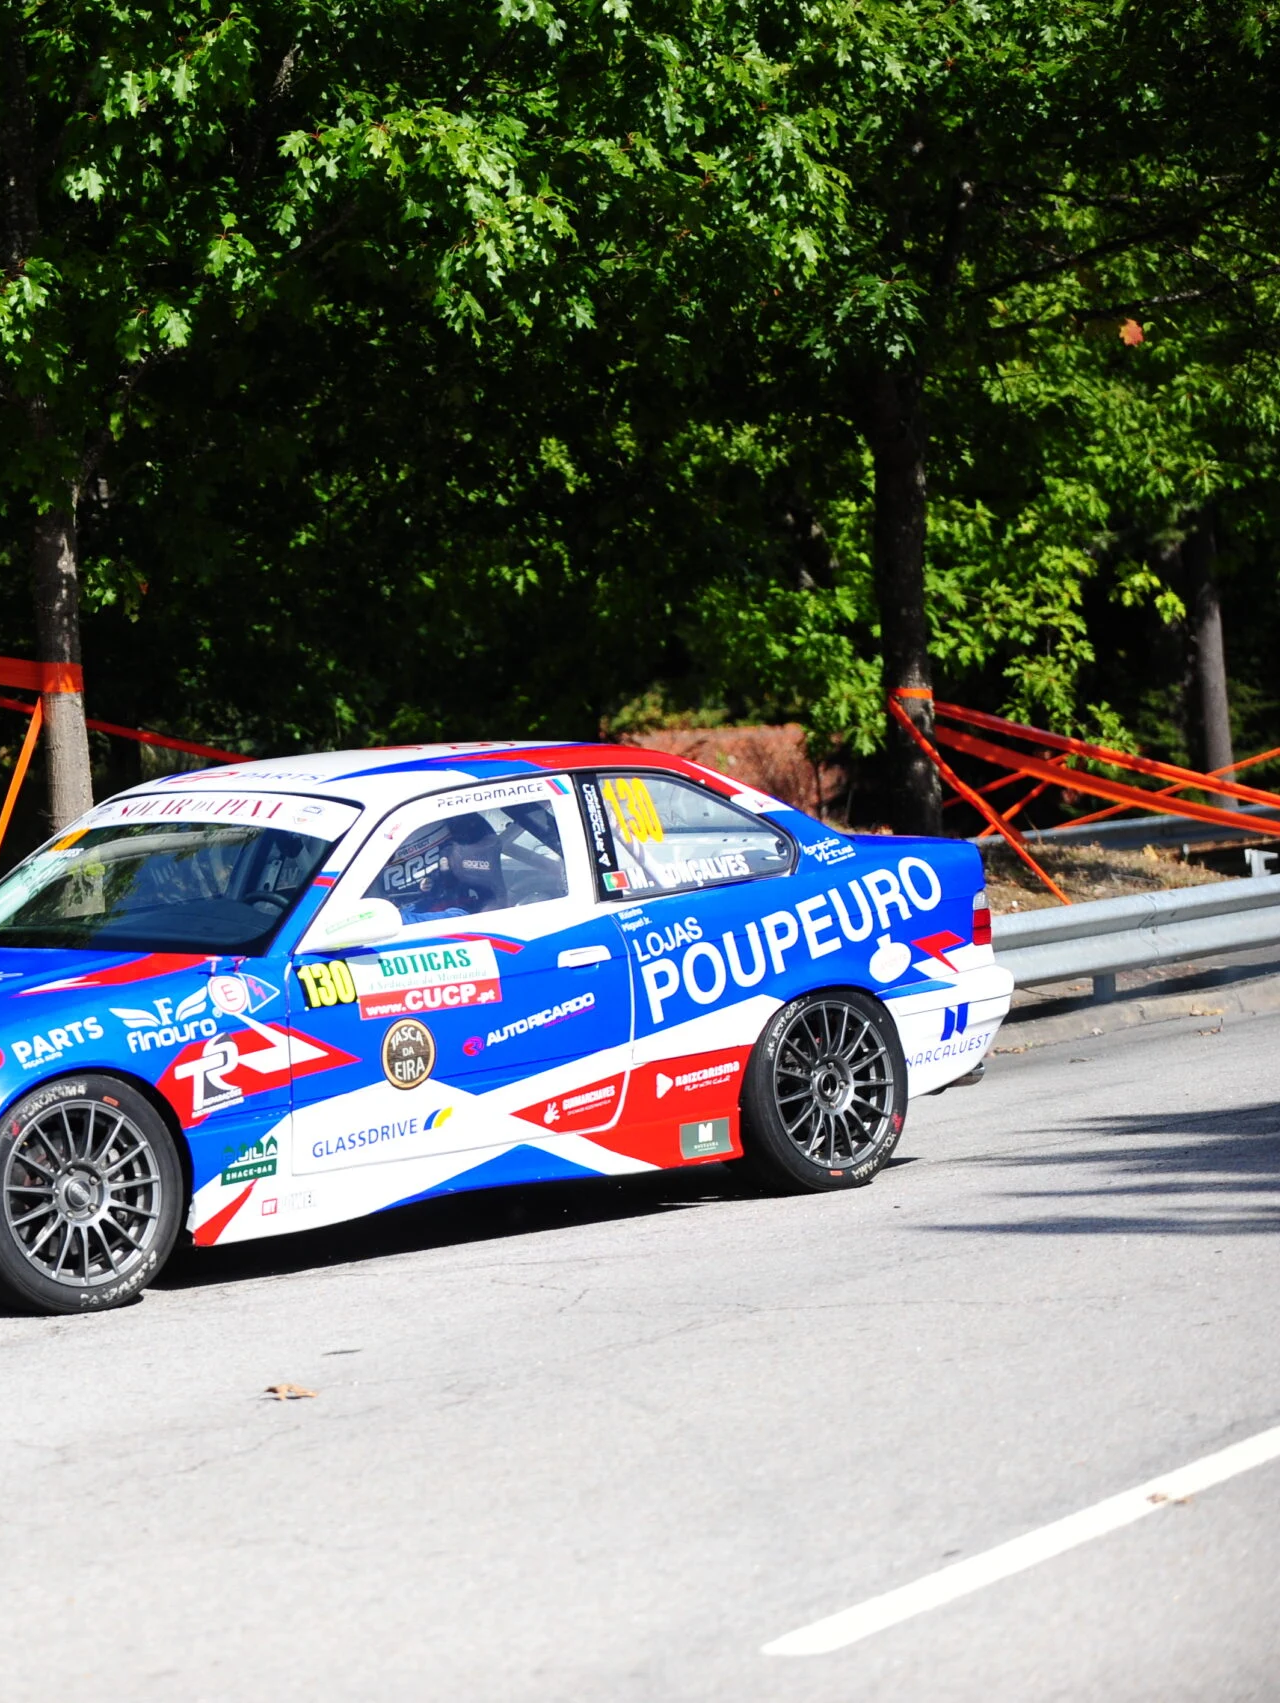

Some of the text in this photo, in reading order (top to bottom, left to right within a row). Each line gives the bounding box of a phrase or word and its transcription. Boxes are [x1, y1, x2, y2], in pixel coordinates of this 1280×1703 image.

[437, 783, 544, 808] PERFORMANCE
[602, 777, 664, 844] 130
[803, 837, 840, 856] Ignição
[814, 845, 854, 862] Virtual
[626, 853, 751, 890] M. GONÇALVES
[632, 917, 703, 962] LOJAS
[640, 856, 942, 1025] POUPEURO
[379, 949, 472, 977] BOTICAS
[297, 960, 357, 1009] 130
[11, 1016, 104, 1064] PARTS
[390, 1026, 424, 1051] TASCA
[402, 1046, 415, 1057] DA
[394, 1056, 426, 1080] EIRA
[312, 1118, 418, 1158] GLASSDRIVE
